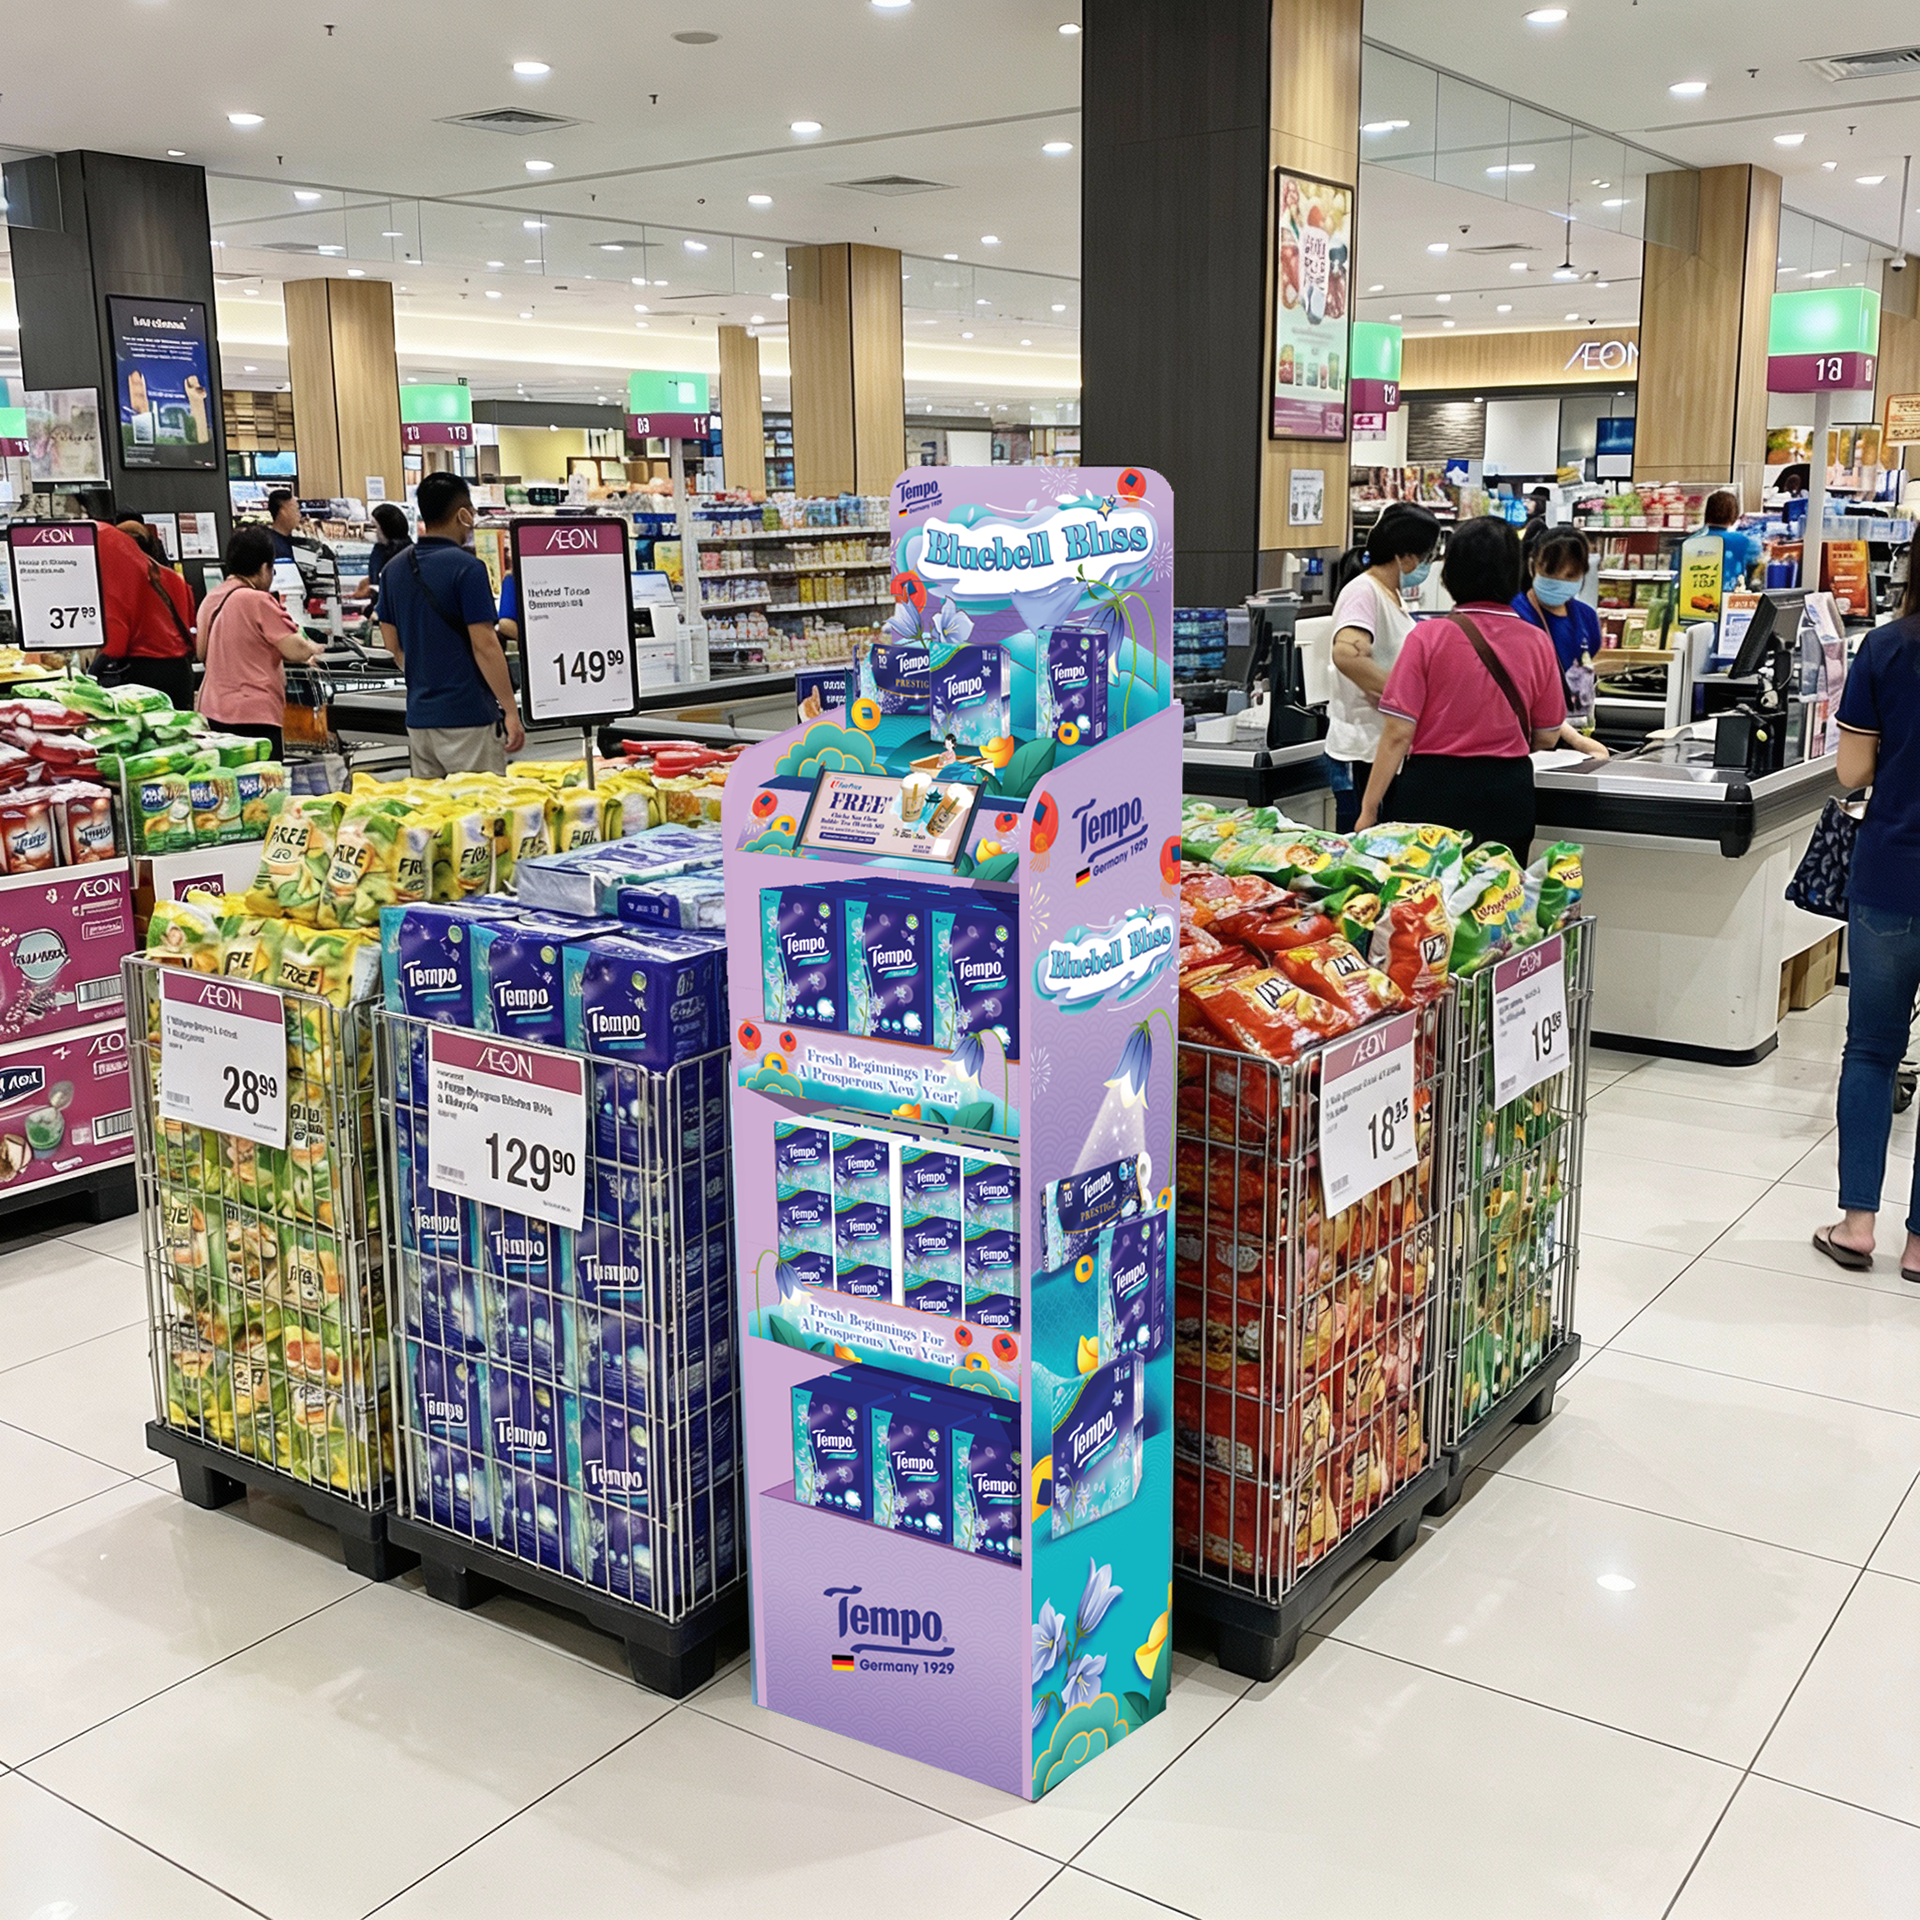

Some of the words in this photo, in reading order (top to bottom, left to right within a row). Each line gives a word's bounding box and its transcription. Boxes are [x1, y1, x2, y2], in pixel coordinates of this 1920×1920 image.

[896, 480, 939, 503] Tempo
[924, 528, 1054, 571] Bluebell
[1061, 521, 1149, 562] Bliss
[896, 652, 930, 673] Tempo
[1051, 663, 1085, 681] Tempo
[895, 678, 930, 688] PRESTIG
[943, 674, 984, 699] Tempo
[1072, 797, 1142, 854] Tempo
[1092, 850, 1129, 877] Germany
[1130, 837, 1149, 857] 1929
[782, 932, 825, 955] Tempo
[1049, 939, 1124, 979] Bluebell
[1127, 926, 1172, 960] Bliss
[867, 944, 913, 967] Tempo
[954, 956, 1002, 980] Tempo
[807, 1049, 843, 1067] Fresh
[848, 1056, 919, 1082] Beginnings
[924, 1069, 947, 1085] For
[798, 1064, 807, 1078] A
[813, 1067, 884, 1091] Prosperous
[888, 1080, 916, 1097] New
[922, 1086, 959, 1104] Year!
[786, 1143, 816, 1159] Tempo
[844, 1155, 875, 1171] Tempo
[914, 1168, 946, 1184] Tempo
[976, 1181, 1009, 1196] Tempo
[1063, 1190, 1073, 1202] 10
[1080, 1171, 1111, 1204] Tempo
[788, 1206, 818, 1221] Tempo
[1080, 1201, 1116, 1222] PRESTIGE
[846, 1218, 877, 1234] Tempo
[915, 1232, 947, 1248] Tempo
[976, 1245, 1009, 1262] Tempo
[848, 1280, 878, 1295] Tempo
[1113, 1261, 1146, 1293] Tempo
[916, 1295, 947, 1311] Tempo
[809, 1303, 844, 1323] Fresh
[849, 1313, 917, 1341] Beginnings
[922, 1330, 944, 1347] For
[977, 1309, 1009, 1325] Tempo
[800, 1317, 809, 1331] A
[815, 1321, 884, 1348] Prosperous
[888, 1338, 915, 1356] New
[920, 1346, 956, 1366] Year!
[811, 1428, 853, 1448] Tempo
[1068, 1410, 1113, 1463] Tempo
[892, 1450, 934, 1471] Tempo
[973, 1473, 1017, 1494] Tempo
[823, 1585, 942, 1646] Tempo
[859, 1659, 919, 1675] Germany
[923, 1662, 955, 1674] 1929
